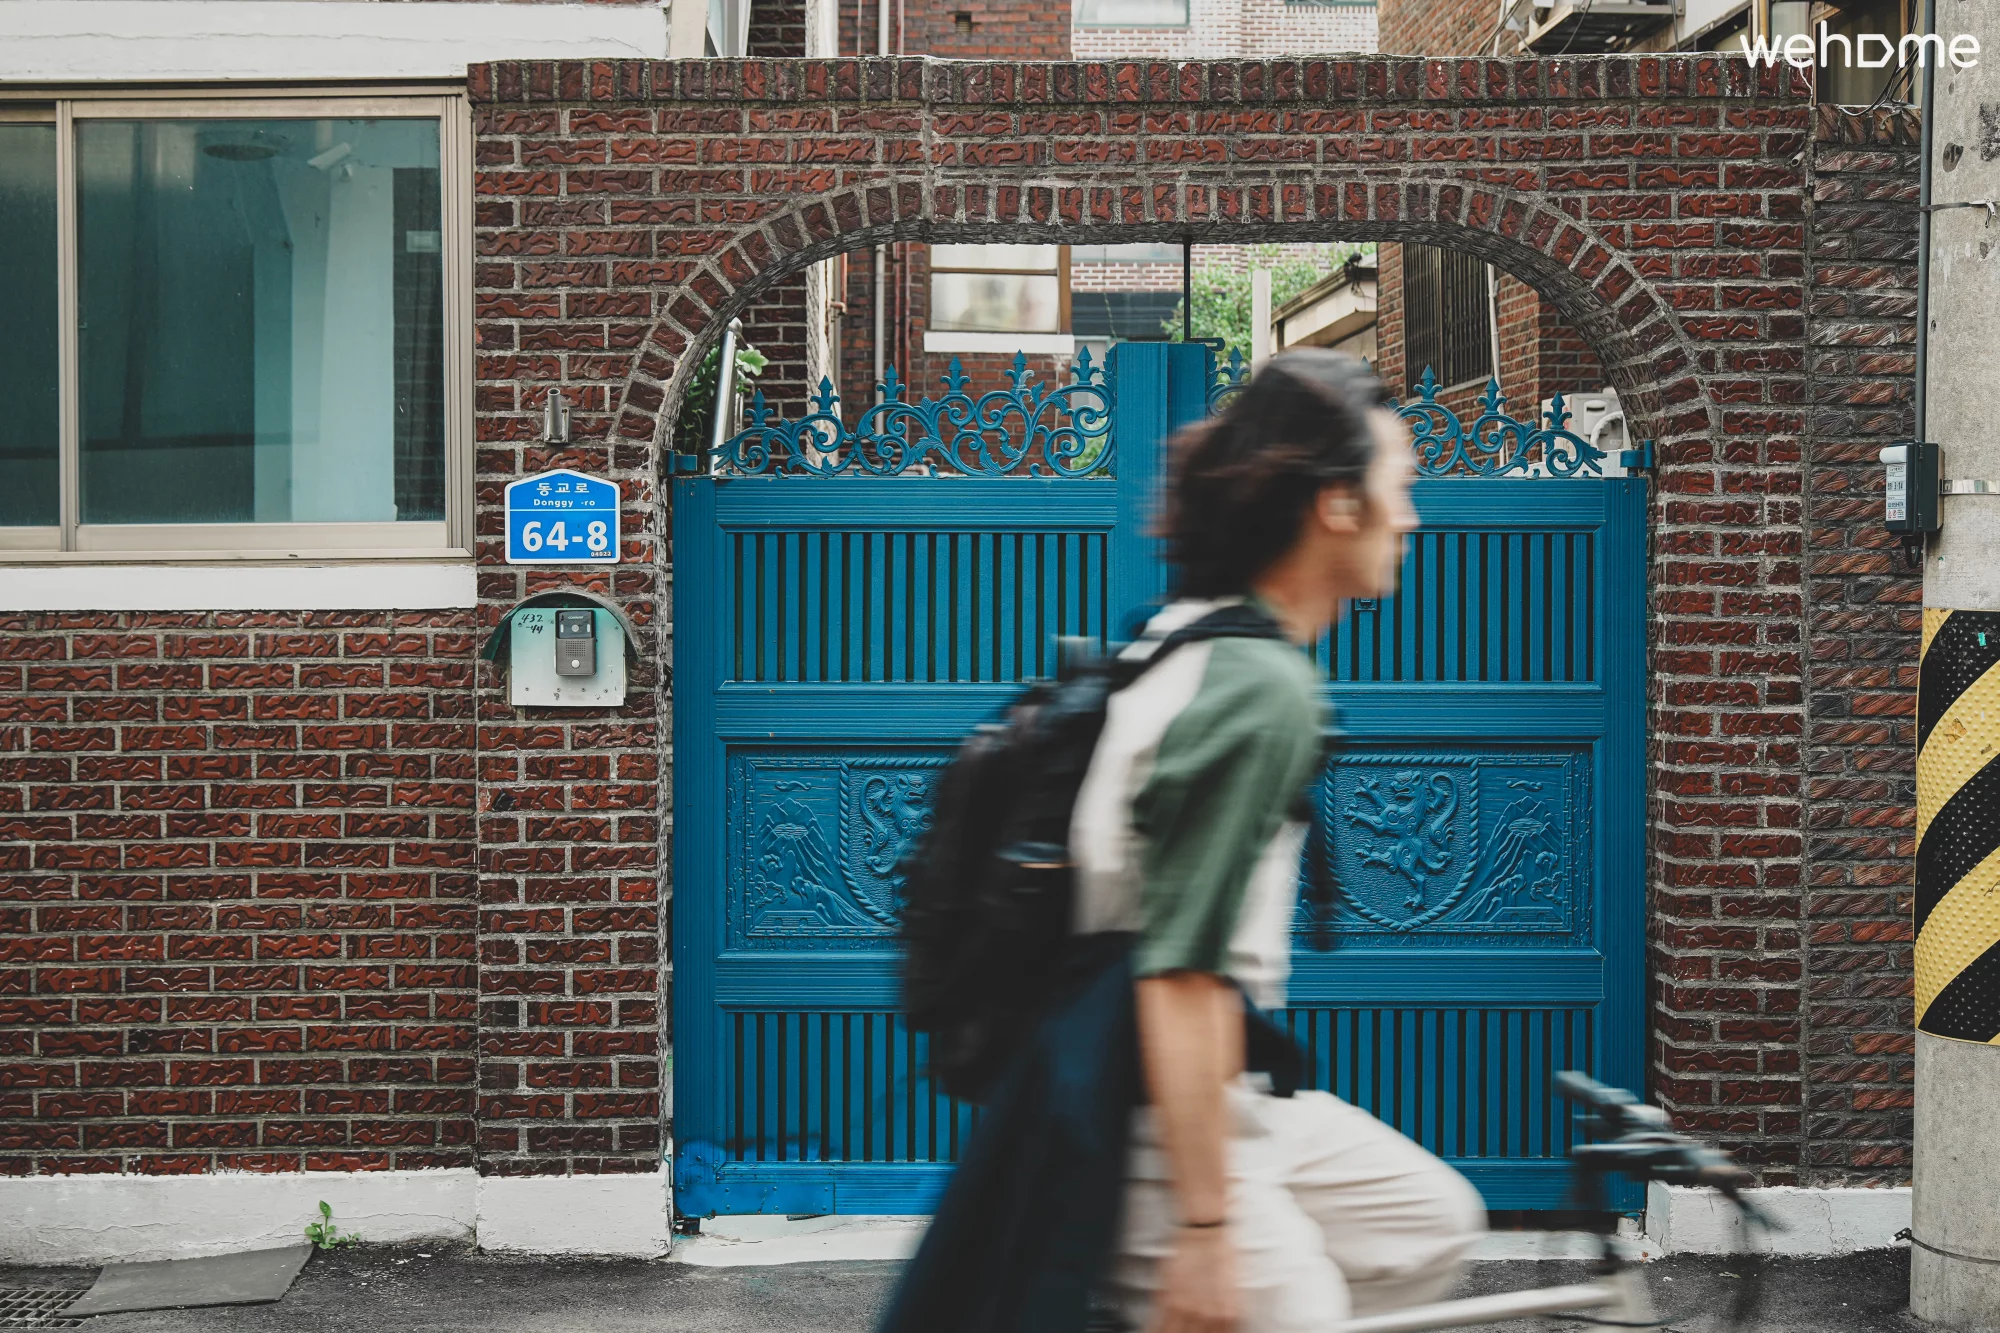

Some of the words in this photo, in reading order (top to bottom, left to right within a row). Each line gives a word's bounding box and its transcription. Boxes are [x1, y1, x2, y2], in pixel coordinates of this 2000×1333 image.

[536, 482, 590, 496] 동교로
[522, 521, 608, 552] 64-8
[521, 613, 544, 623] 432
